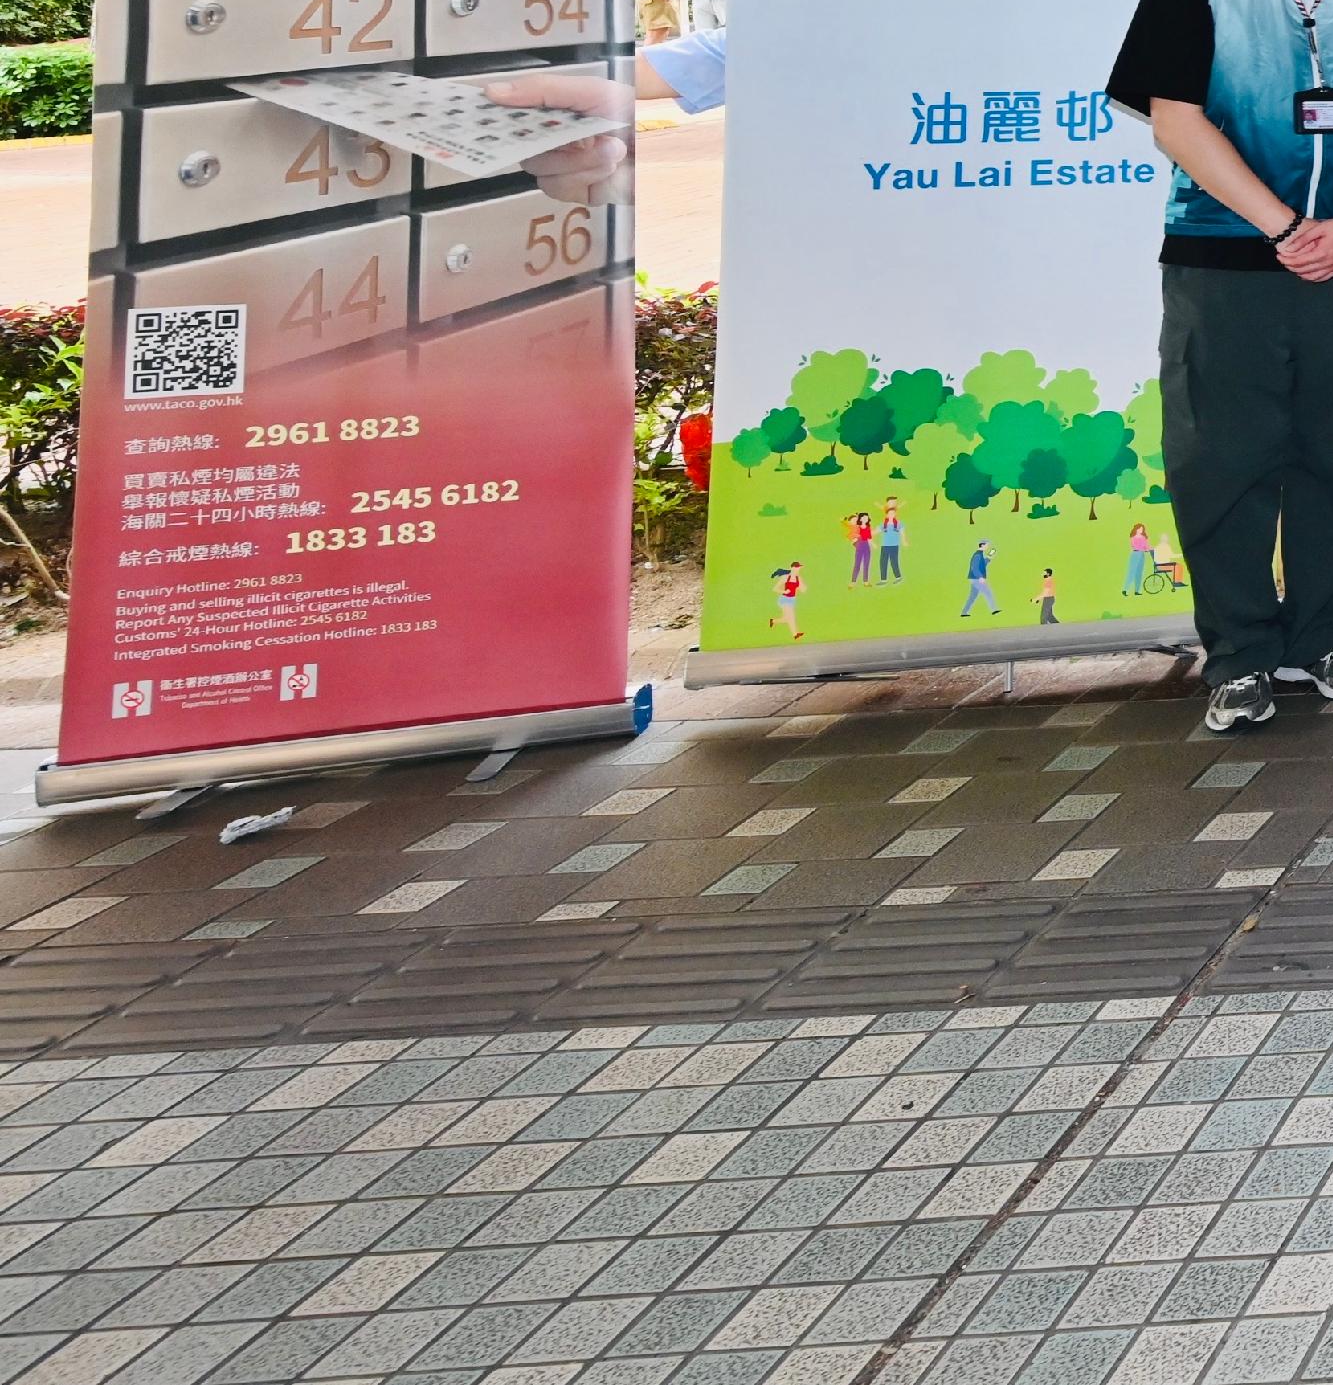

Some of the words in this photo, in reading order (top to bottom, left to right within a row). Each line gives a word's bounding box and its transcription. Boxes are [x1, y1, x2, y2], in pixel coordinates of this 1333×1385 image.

[908, 90, 1115, 146] 油麗邨
[284, 124, 391, 197] 43
[863, 162, 939, 192] Yau
[955, 161, 1013, 190] Lai
[1029, 158, 1156, 187] Estate
[524, 205, 593, 277] 56
[279, 254, 388, 339] 44
[124, 395, 245, 413] www.taco.gov.hk
[245, 420, 331, 449] 2961
[339, 415, 421, 442] 8823
[123, 462, 301, 491] 買賣私煙均屬違法
[121, 483, 301, 511] 舉報懷疑私煙活動
[350, 486, 433, 515] 2545
[440, 479, 521, 507] 6182
[285, 525, 369, 555] 1833
[376, 520, 437, 548] 183
[115, 604, 167, 618] Buying
[169, 599, 196, 612] and
[198, 594, 245, 609] selling
[247, 591, 281, 605] illicit
[283, 585, 350, 604] cigarettes
[352, 584, 365, 596] is
[366, 579, 410, 595] illegal.
[116, 585, 174, 600] Enquiry
[176, 581, 231, 596] Hotline:
[234, 576, 267, 589] 2961
[270, 572, 303, 586] 8823
[114, 627, 182, 645] Customs'
[184, 622, 241, 638] 24-Hour
[243, 617, 298, 632] Hotline:
[300, 613, 333, 627] 2545
[335, 609, 369, 623] 6182
[115, 617, 165, 632] Report
[167, 613, 195, 627] Any
[197, 605, 270, 623] Suspected
[272, 601, 306, 616] Illicit
[308, 596, 370, 614] Cigarette
[371, 591, 433, 607] Activities
[113, 642, 188, 662] Integrated
[190, 638, 253, 654] Smoking
[254, 629, 321, 648] Cessation
[323, 625, 378, 641] Hotline:
[381, 620, 412, 635] 1833
[414, 618, 438, 632] 183
